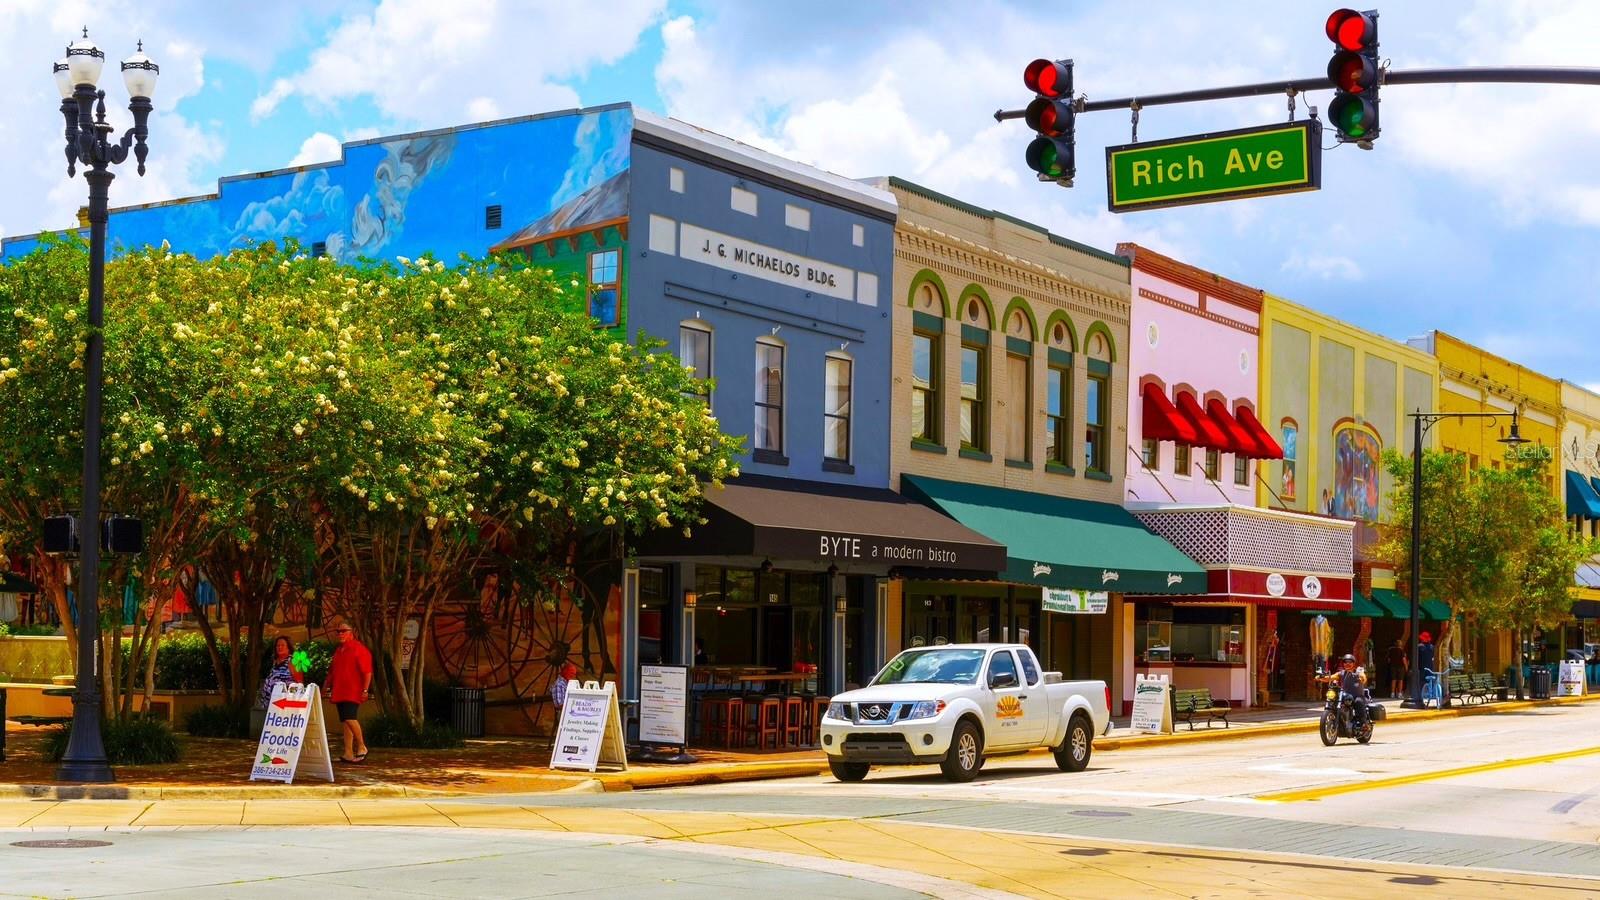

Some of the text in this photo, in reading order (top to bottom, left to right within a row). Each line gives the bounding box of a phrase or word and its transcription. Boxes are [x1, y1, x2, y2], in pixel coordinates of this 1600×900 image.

[1132, 148, 1284, 187] Rich Ave
[702, 239, 837, 288] J. G. MICHAELOS BLDG.
[820, 536, 957, 563] BYTE a modern bistro
[266, 712, 304, 728] Health
[261, 731, 299, 747] Foods
[267, 747, 275, 755] for
